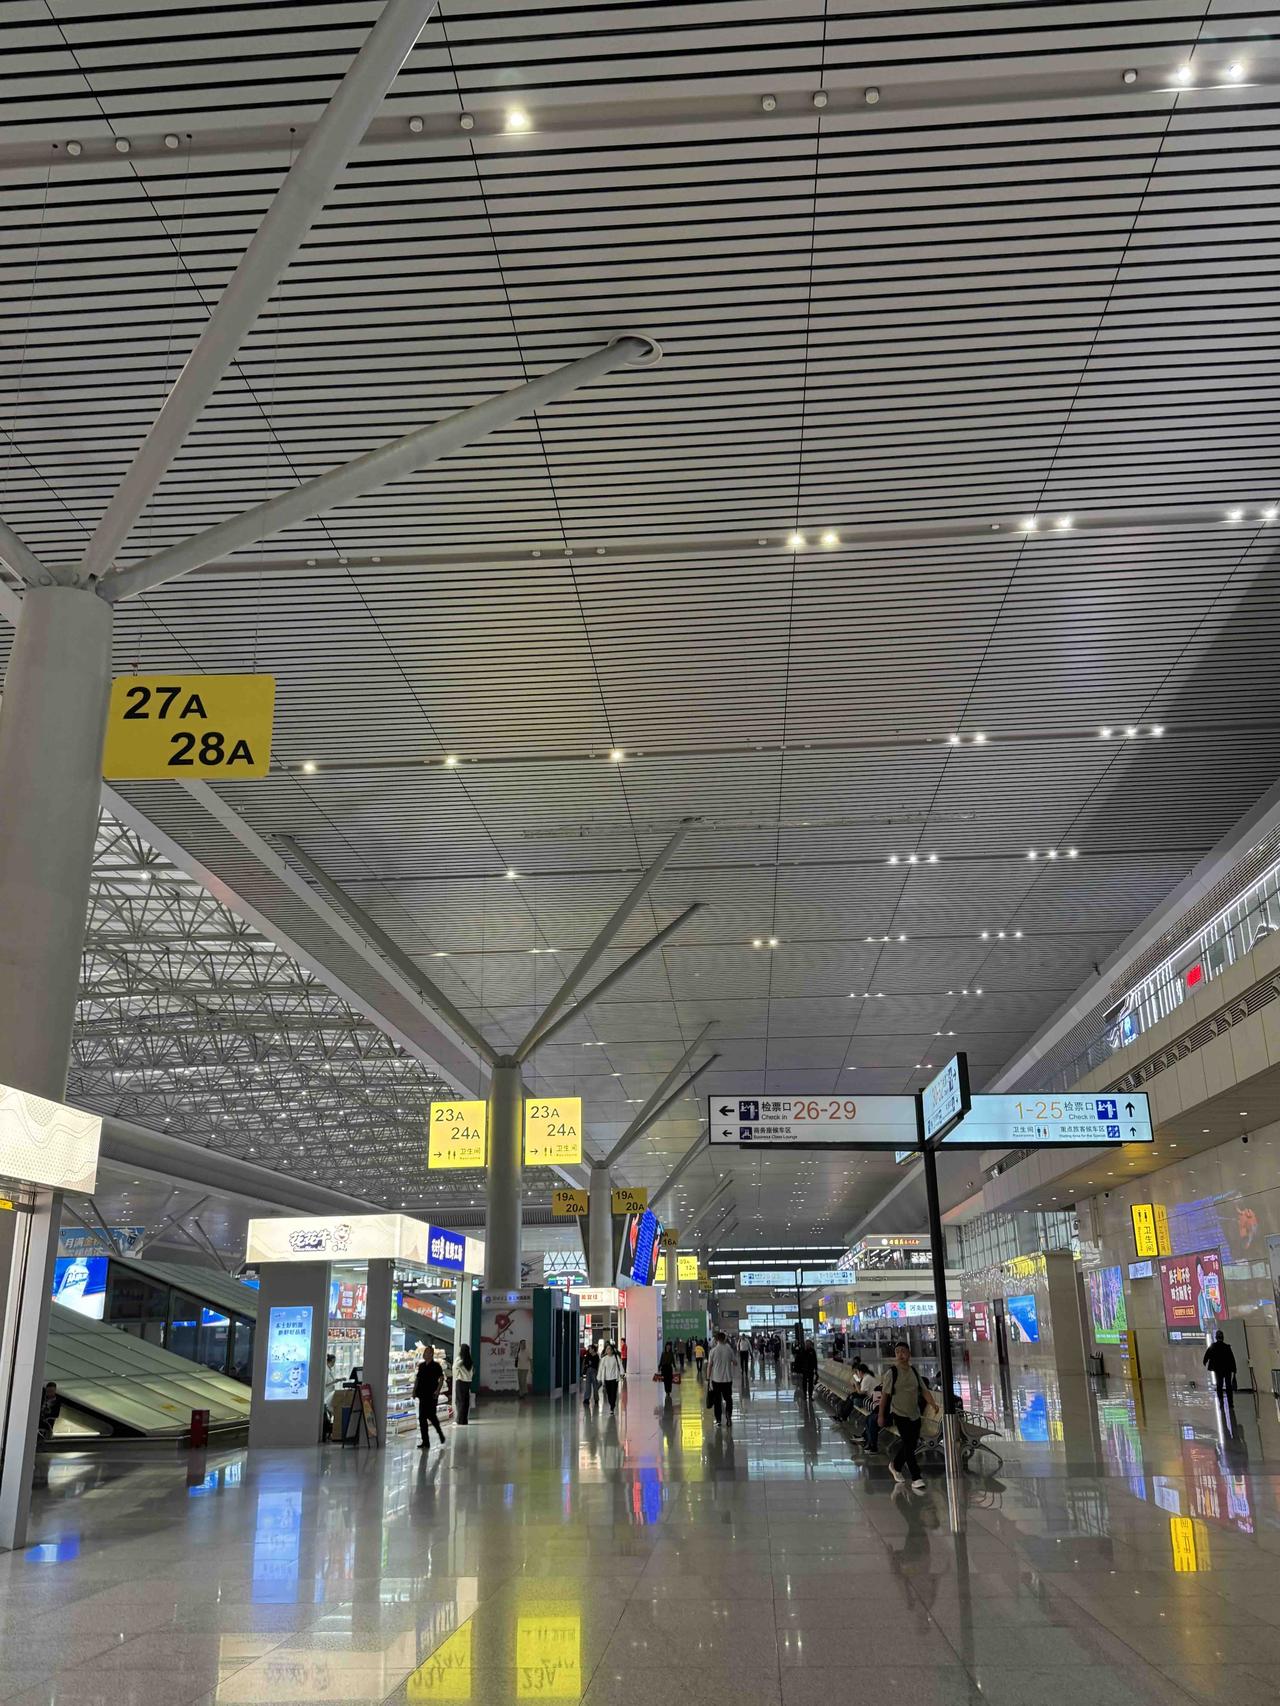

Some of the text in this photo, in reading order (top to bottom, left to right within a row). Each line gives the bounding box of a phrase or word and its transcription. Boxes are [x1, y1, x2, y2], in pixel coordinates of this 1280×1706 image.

[123, 686, 208, 719] 27A
[167, 731, 255, 766] 28A
[434, 1108, 465, 1122] 23A
[530, 1105, 560, 1119] 23A
[761, 1101, 857, 1120] 检票口 26-29
[1015, 1101, 1094, 1120] 1-25 检票口
[450, 1126, 481, 1140] 24A
[547, 1123, 577, 1137] 24A
[556, 1192, 575, 1201] 19A
[615, 1190, 634, 1200] 19A
[565, 1203, 585, 1213] 20A
[625, 1202, 645, 1211] 20A
[289, 1229, 332, 1248] 花花牛
[663, 1238, 677, 1246] 16A
